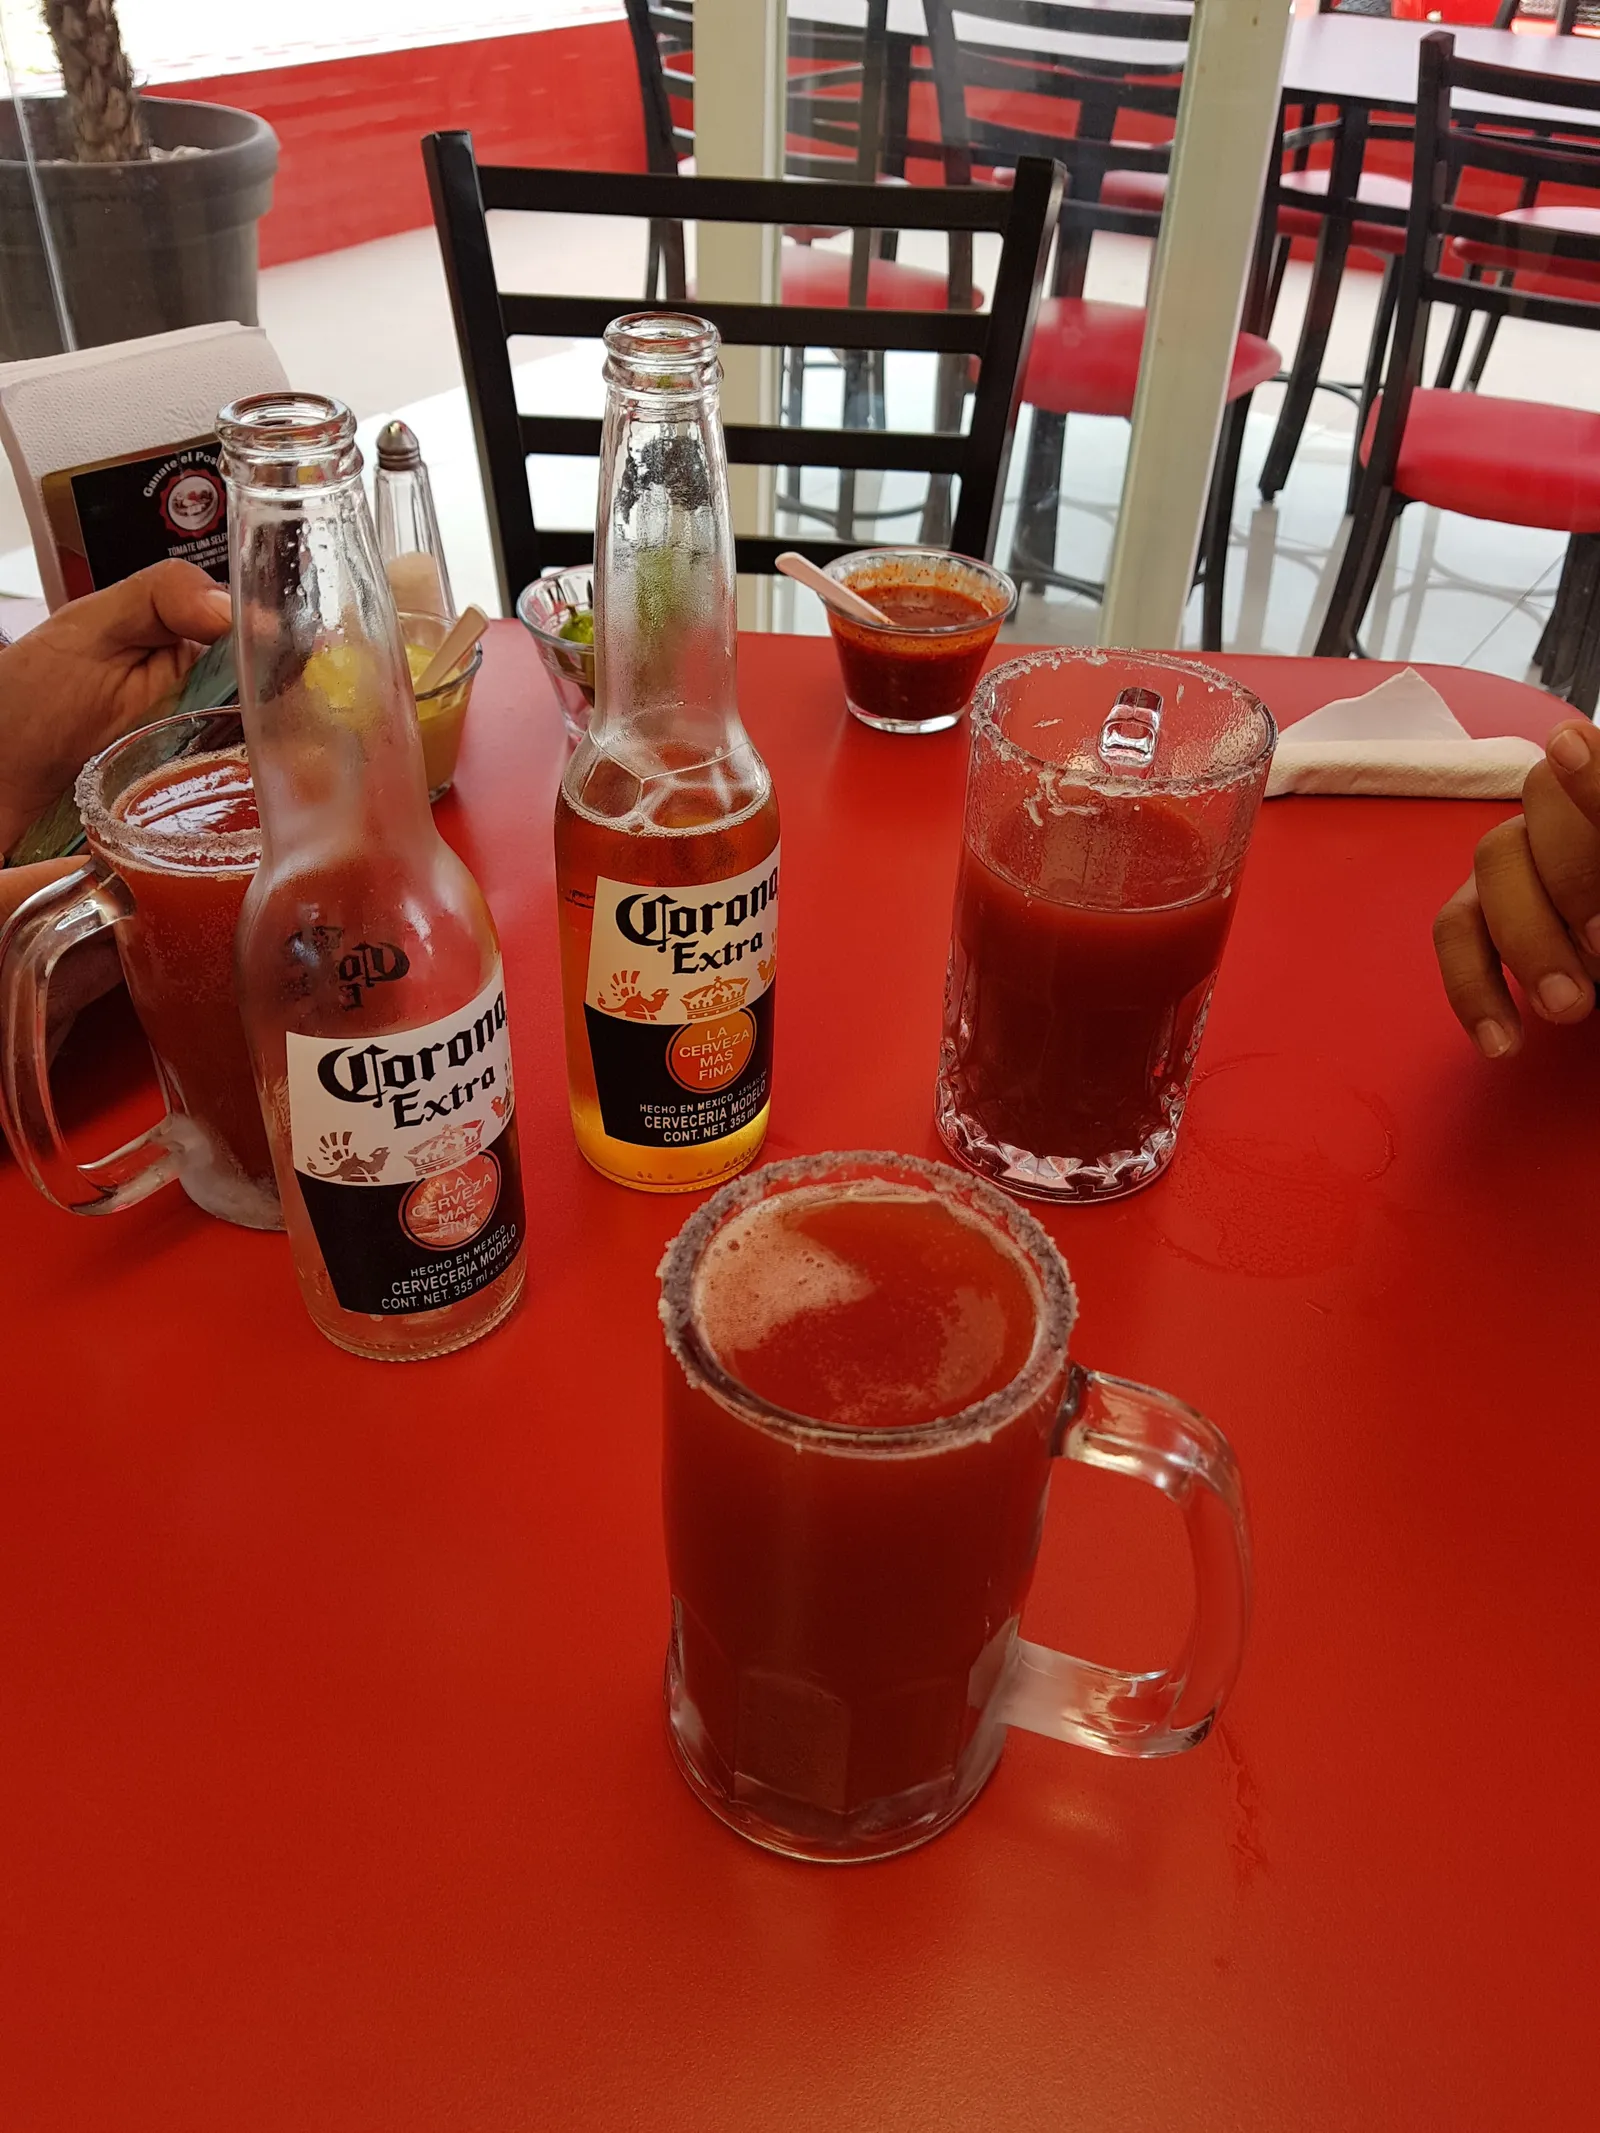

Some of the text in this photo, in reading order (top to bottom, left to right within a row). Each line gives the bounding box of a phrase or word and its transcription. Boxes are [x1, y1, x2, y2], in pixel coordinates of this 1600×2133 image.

[180, 452, 192, 464] el
[615, 866, 778, 953] Corona
[671, 932, 763, 975] Extra
[317, 990, 508, 1108] Corona
[679, 1029, 750, 1058] CERVEZA
[706, 1026, 728, 1041] LA
[699, 1062, 734, 1081] FINA
[700, 1049, 734, 1068] MAS
[389, 1066, 496, 1129] Extra
[640, 1093, 734, 1114] HECHO EN MEXICO
[644, 1080, 766, 1129] CERVECERIA MODELO
[663, 1103, 757, 1142] CONT. NET. 355 ml
[411, 1173, 493, 1217] CERVEZA
[442, 1176, 466, 1195] LA
[437, 1200, 476, 1224] MAS
[438, 1213, 479, 1236] FINA
[391, 1223, 517, 1295] CERVECERIA MODELO
[410, 1224, 506, 1277] HECHO EN MEXICO
[381, 1297, 420, 1310] CONT.
[423, 1289, 451, 1305] NET.
[453, 1278, 473, 1296] 355
[476, 1269, 488, 1287] ml
